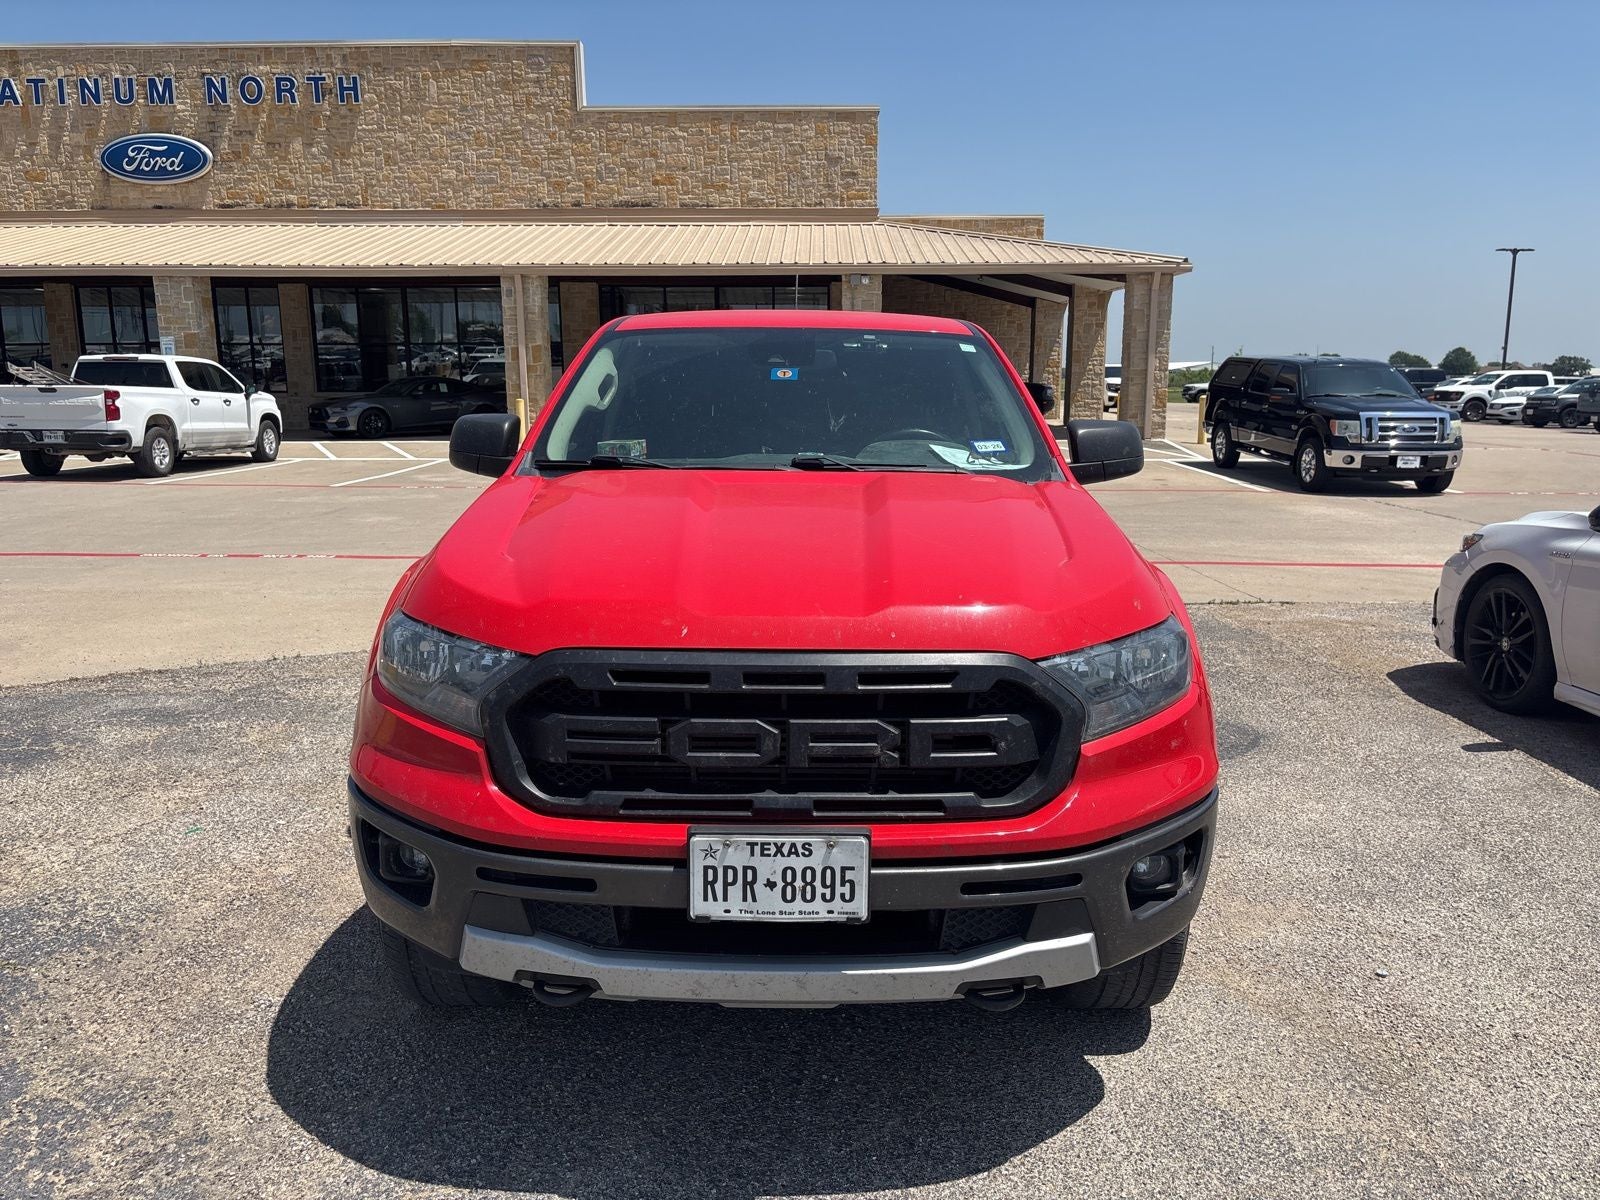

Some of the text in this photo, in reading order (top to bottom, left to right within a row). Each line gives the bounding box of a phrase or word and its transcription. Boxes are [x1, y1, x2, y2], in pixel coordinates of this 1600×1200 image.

[0, 75, 362, 106] ATINUM NORTH
[122, 144, 184, 172] Ford
[536, 713, 1039, 768] FORD
[746, 842, 813, 857] TEXAS
[702, 865, 856, 904] RPR 8895
